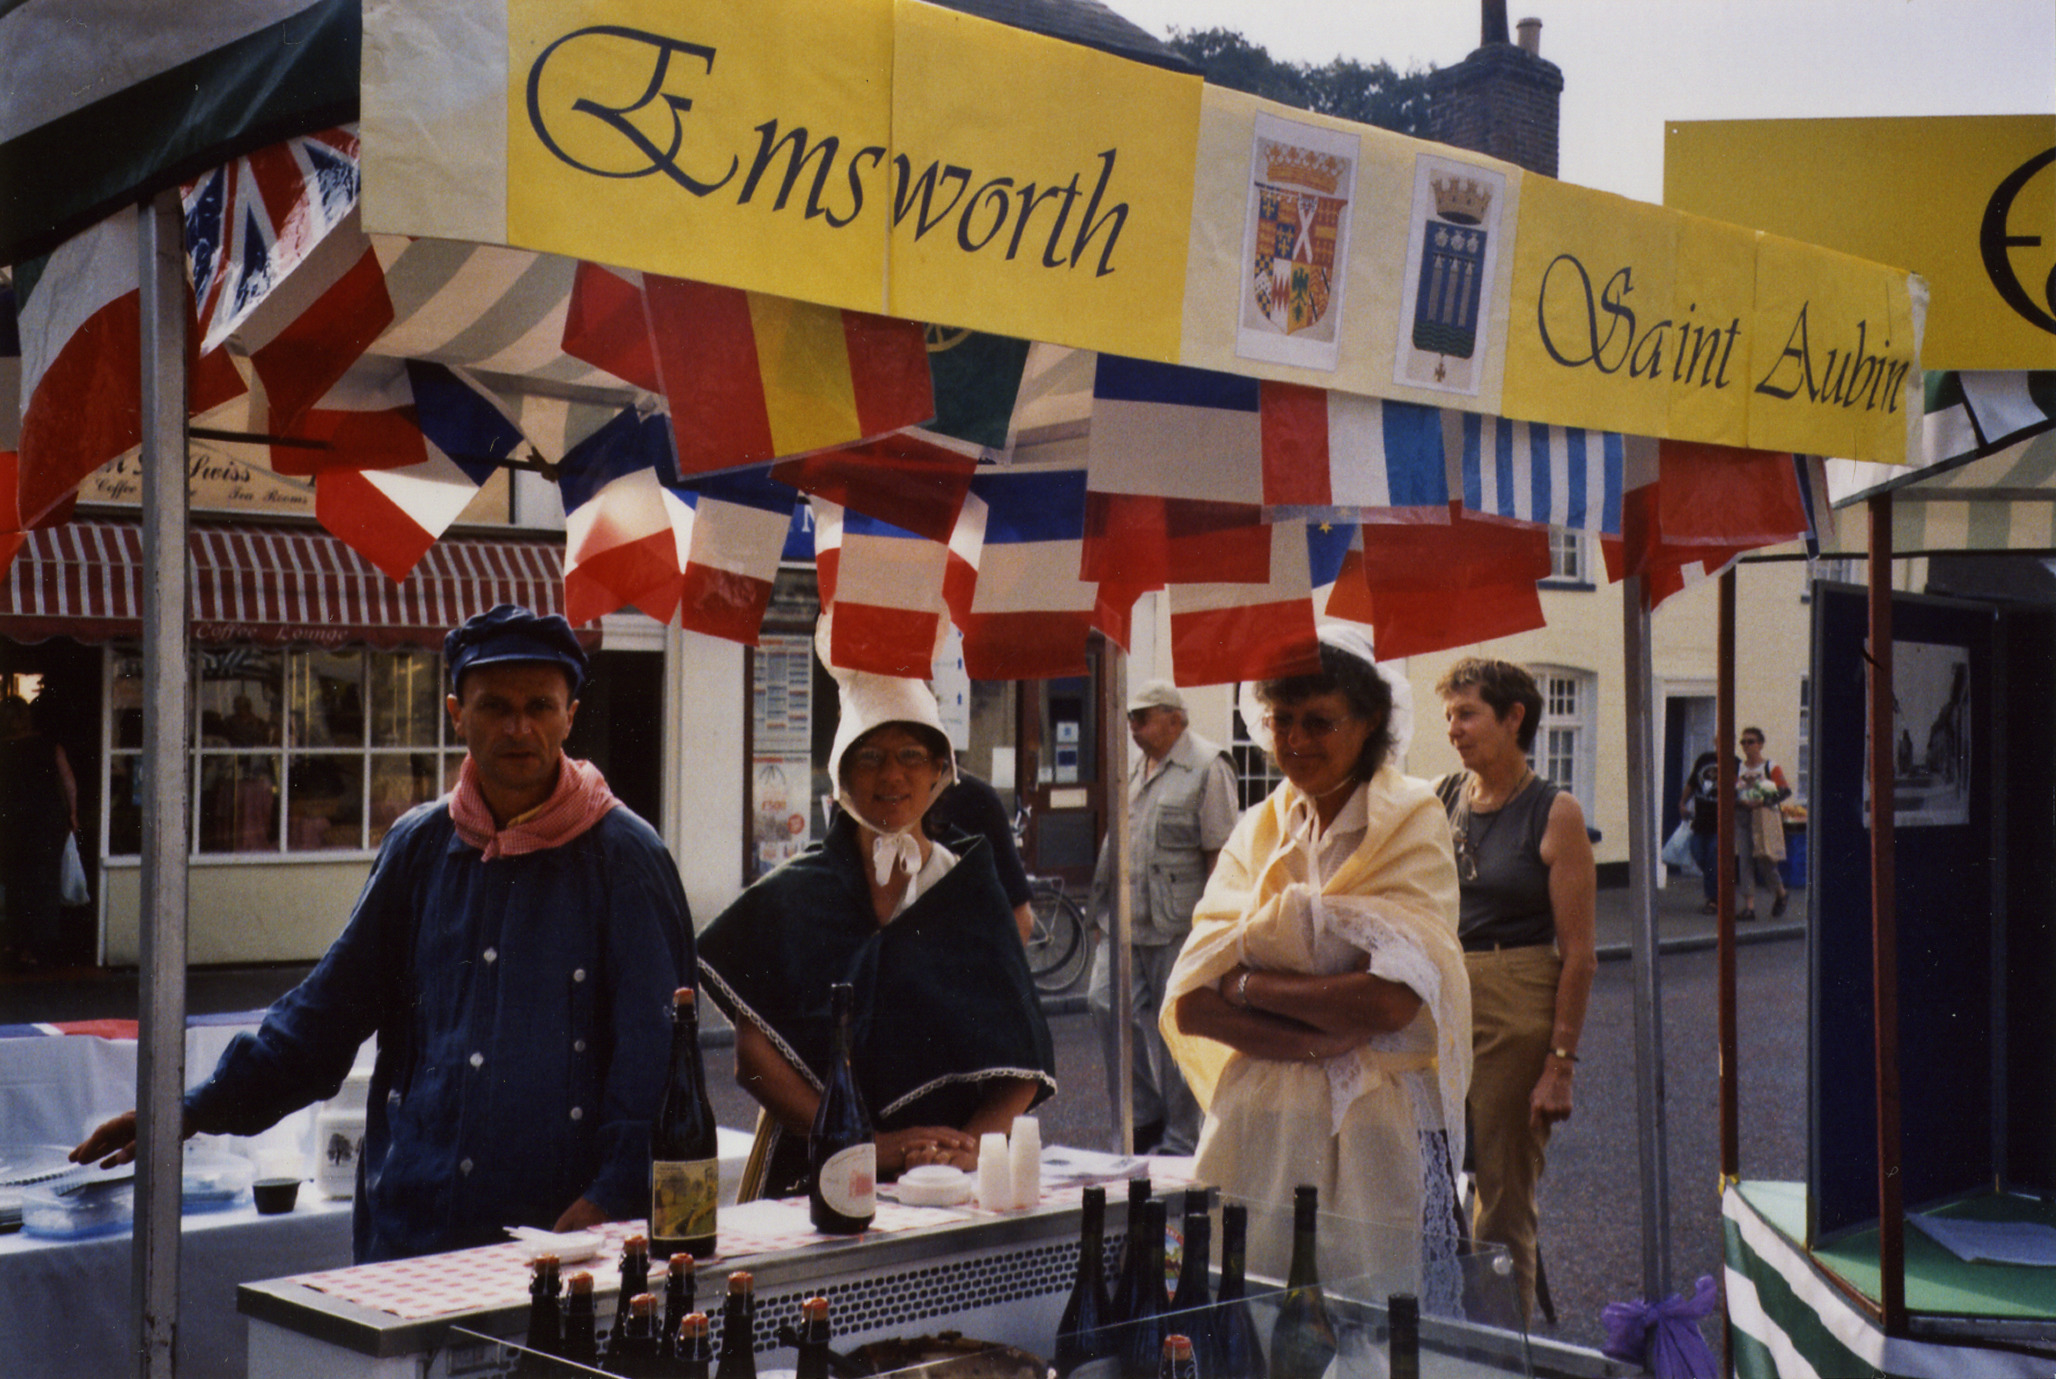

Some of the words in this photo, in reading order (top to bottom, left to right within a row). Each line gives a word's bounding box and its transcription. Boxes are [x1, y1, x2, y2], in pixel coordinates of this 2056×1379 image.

[526, 25, 1130, 278] Emsworth
[1538, 254, 1740, 390] Saint
[1754, 301, 1911, 414] Aubin
[96, 478, 138, 500] Coffee
[196, 623, 258, 640] Coffee
[275, 625, 349, 642] Lounge
